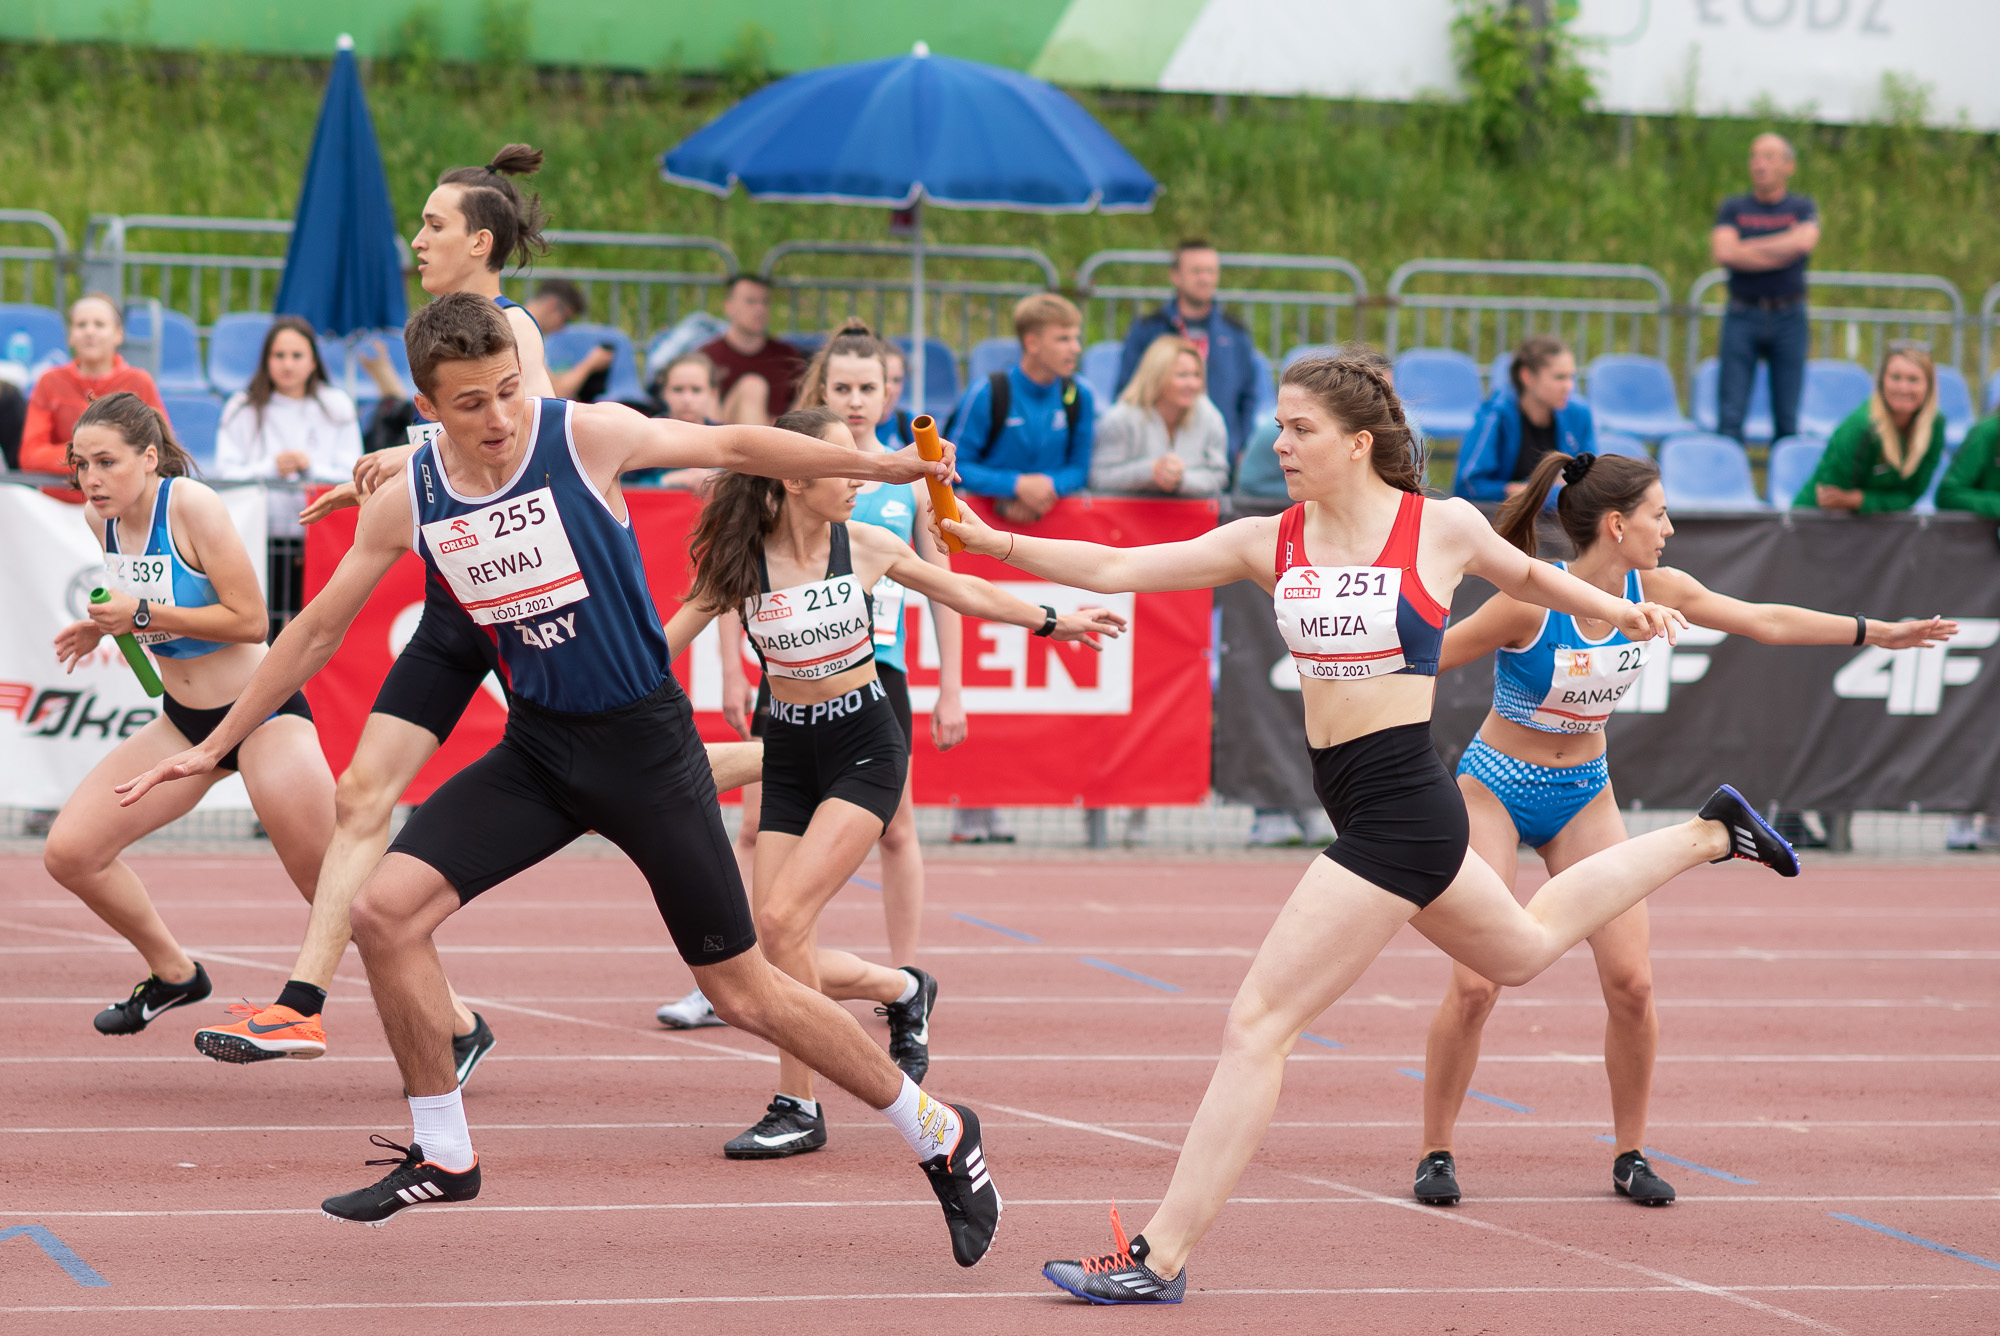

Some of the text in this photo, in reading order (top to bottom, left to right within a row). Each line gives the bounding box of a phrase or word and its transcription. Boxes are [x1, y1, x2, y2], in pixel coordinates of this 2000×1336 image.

[421, 463, 434, 503] COLO
[489, 498, 546, 539] 255
[441, 536, 477, 553] ORLEN
[1286, 540, 1294, 570] COL
[133, 561, 164, 583] 539
[467, 547, 543, 586] REWAJ
[804, 582, 852, 612] 219
[1285, 588, 1320, 599] ORLEN
[1335, 572, 1387, 598] 251
[491, 596, 555, 620] ŁÓDŹ 2021
[758, 607, 791, 621] ORLEN
[149, 632, 173, 643] 2021
[761, 617, 865, 650] JABŁOŃSKA
[1300, 615, 1368, 638] MEJZA
[791, 659, 849, 678] ŁÓDŹ 2021
[1312, 662, 1371, 677] ŁÓDŹ 2021
[1833, 617, 2000, 715] 4F
[770, 693, 807, 725] NIKE
[811, 689, 863, 725] PRO
